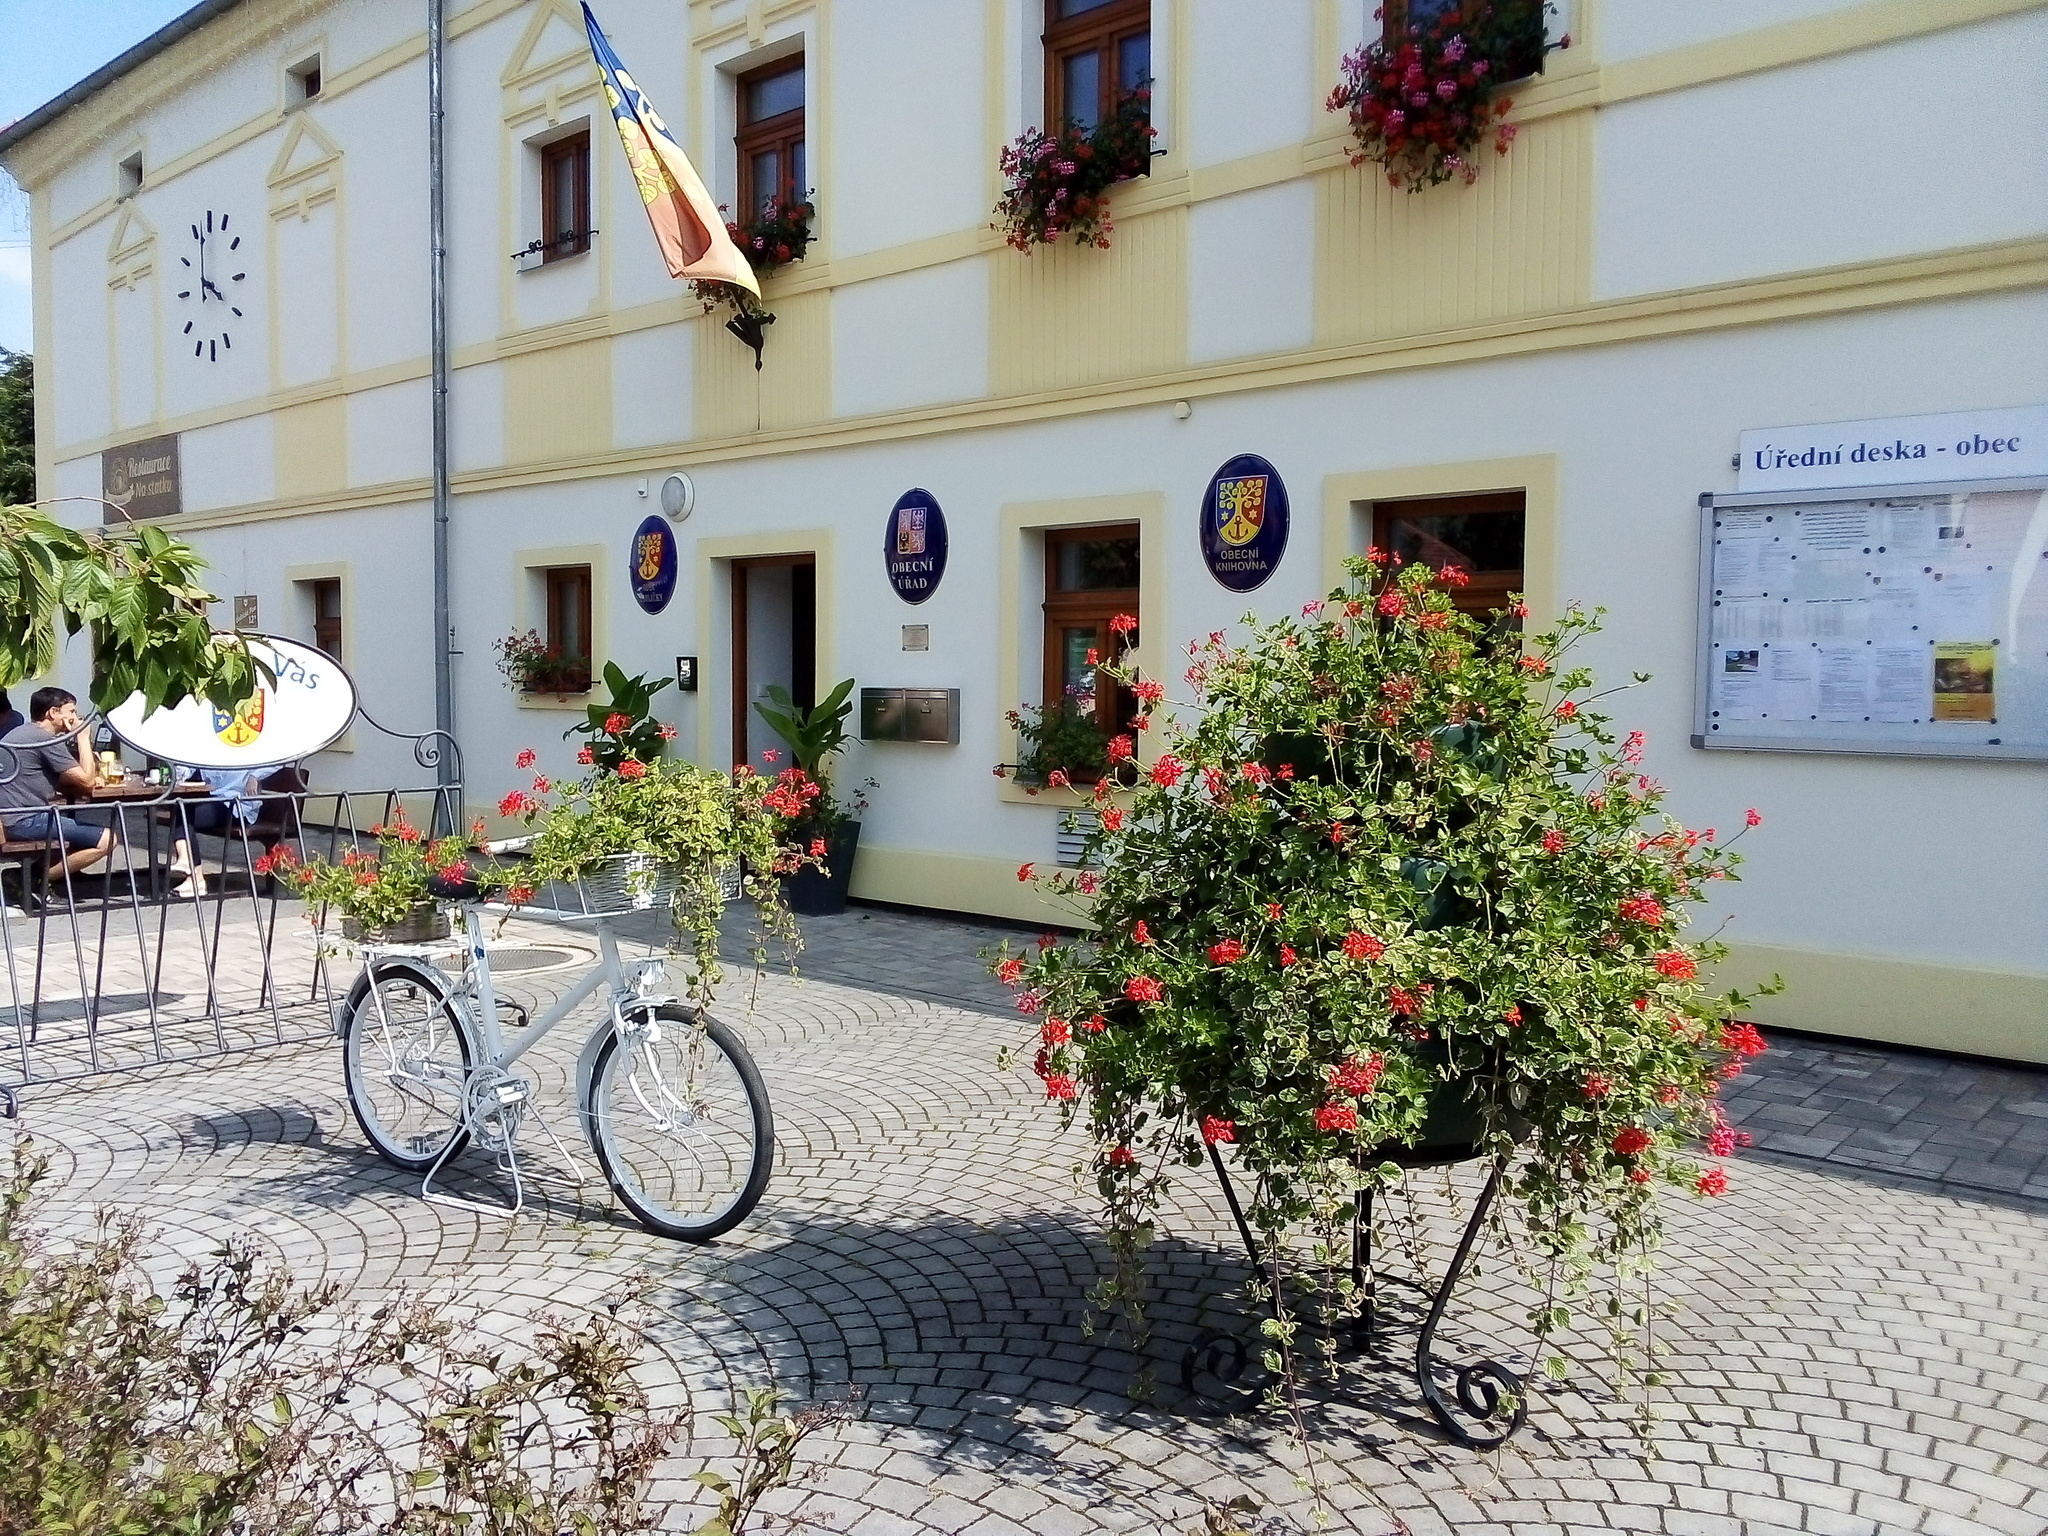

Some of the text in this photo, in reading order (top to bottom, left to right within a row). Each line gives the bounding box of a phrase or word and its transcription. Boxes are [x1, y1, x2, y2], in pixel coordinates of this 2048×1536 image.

[1755, 444, 1844, 470] Úřední
[1850, 440, 1927, 464] deska
[1956, 434, 2021, 456] obec
[1220, 547, 1259, 560] OBECNÍ
[892, 557, 934, 573] OBECNÍ
[1215, 560, 1268, 572] KNIHOVNA
[898, 575, 928, 590] ÚŘAD
[274, 653, 320, 689] Vás
